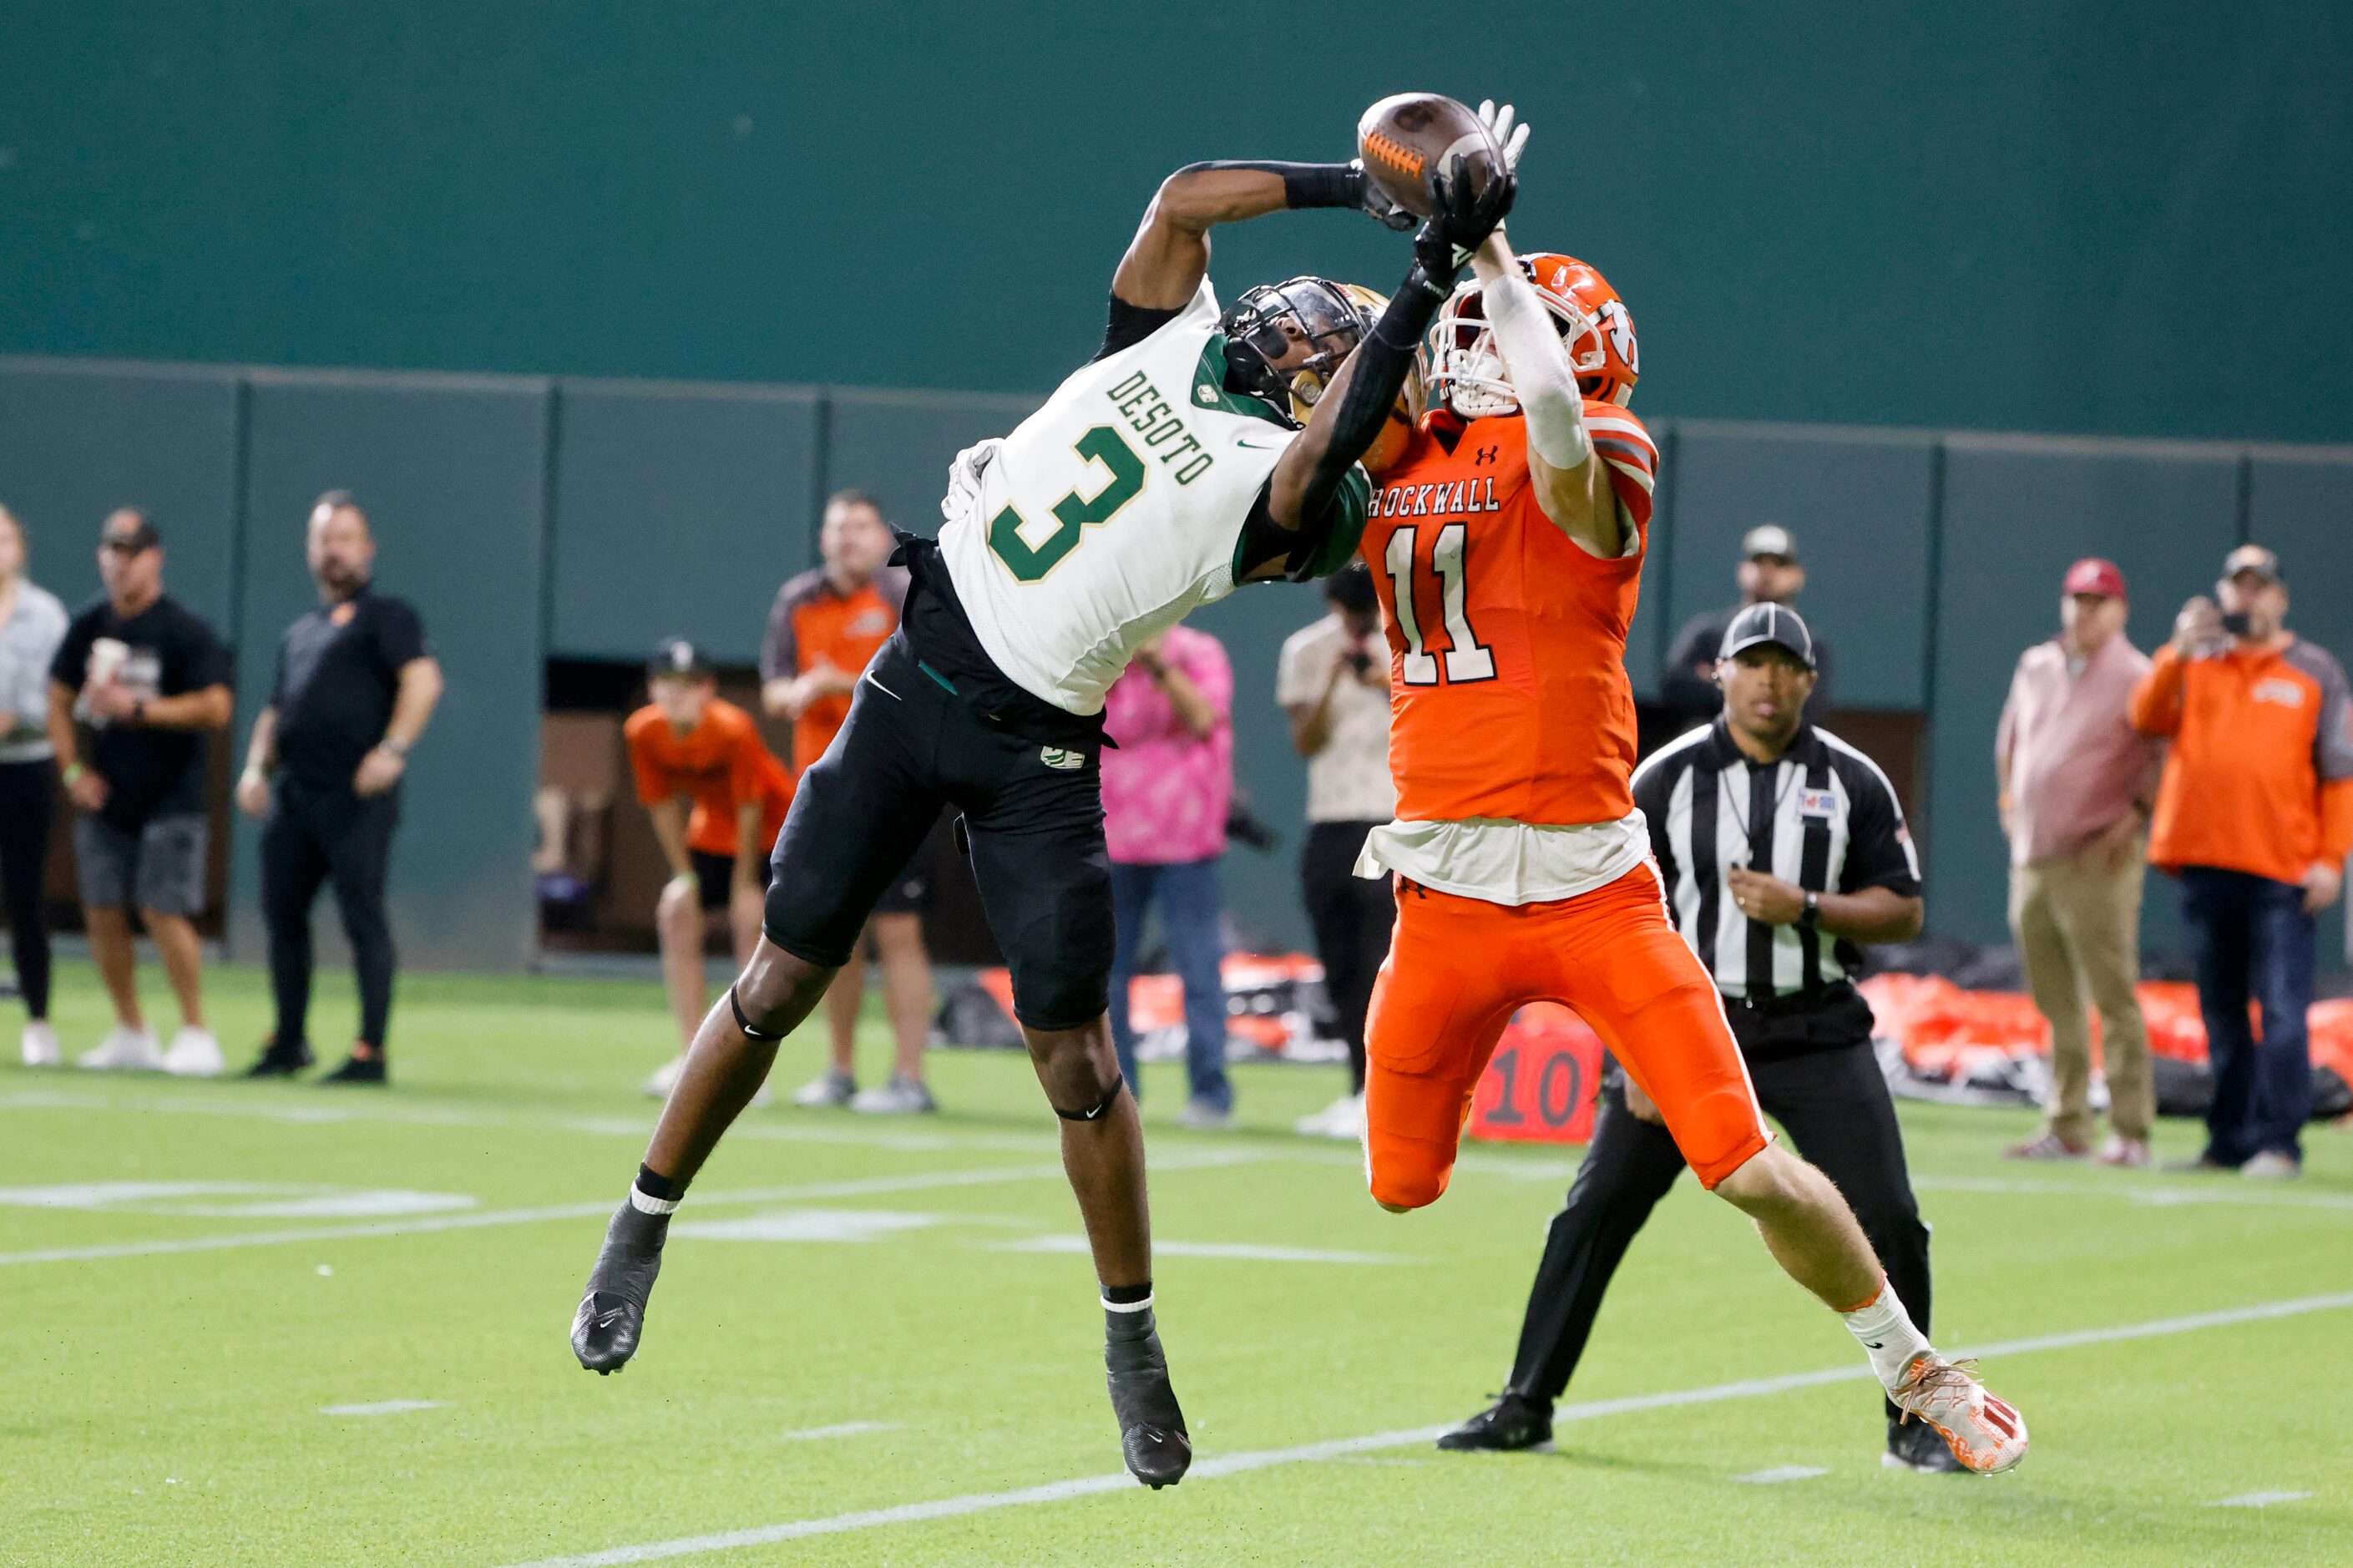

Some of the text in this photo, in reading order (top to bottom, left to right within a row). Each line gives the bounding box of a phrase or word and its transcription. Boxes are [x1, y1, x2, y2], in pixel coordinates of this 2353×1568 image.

[1106, 370, 1213, 485] DESOTO
[987, 423, 1149, 584] 3
[1385, 522, 1498, 686] 11
[1485, 1049, 1581, 1127] 10
